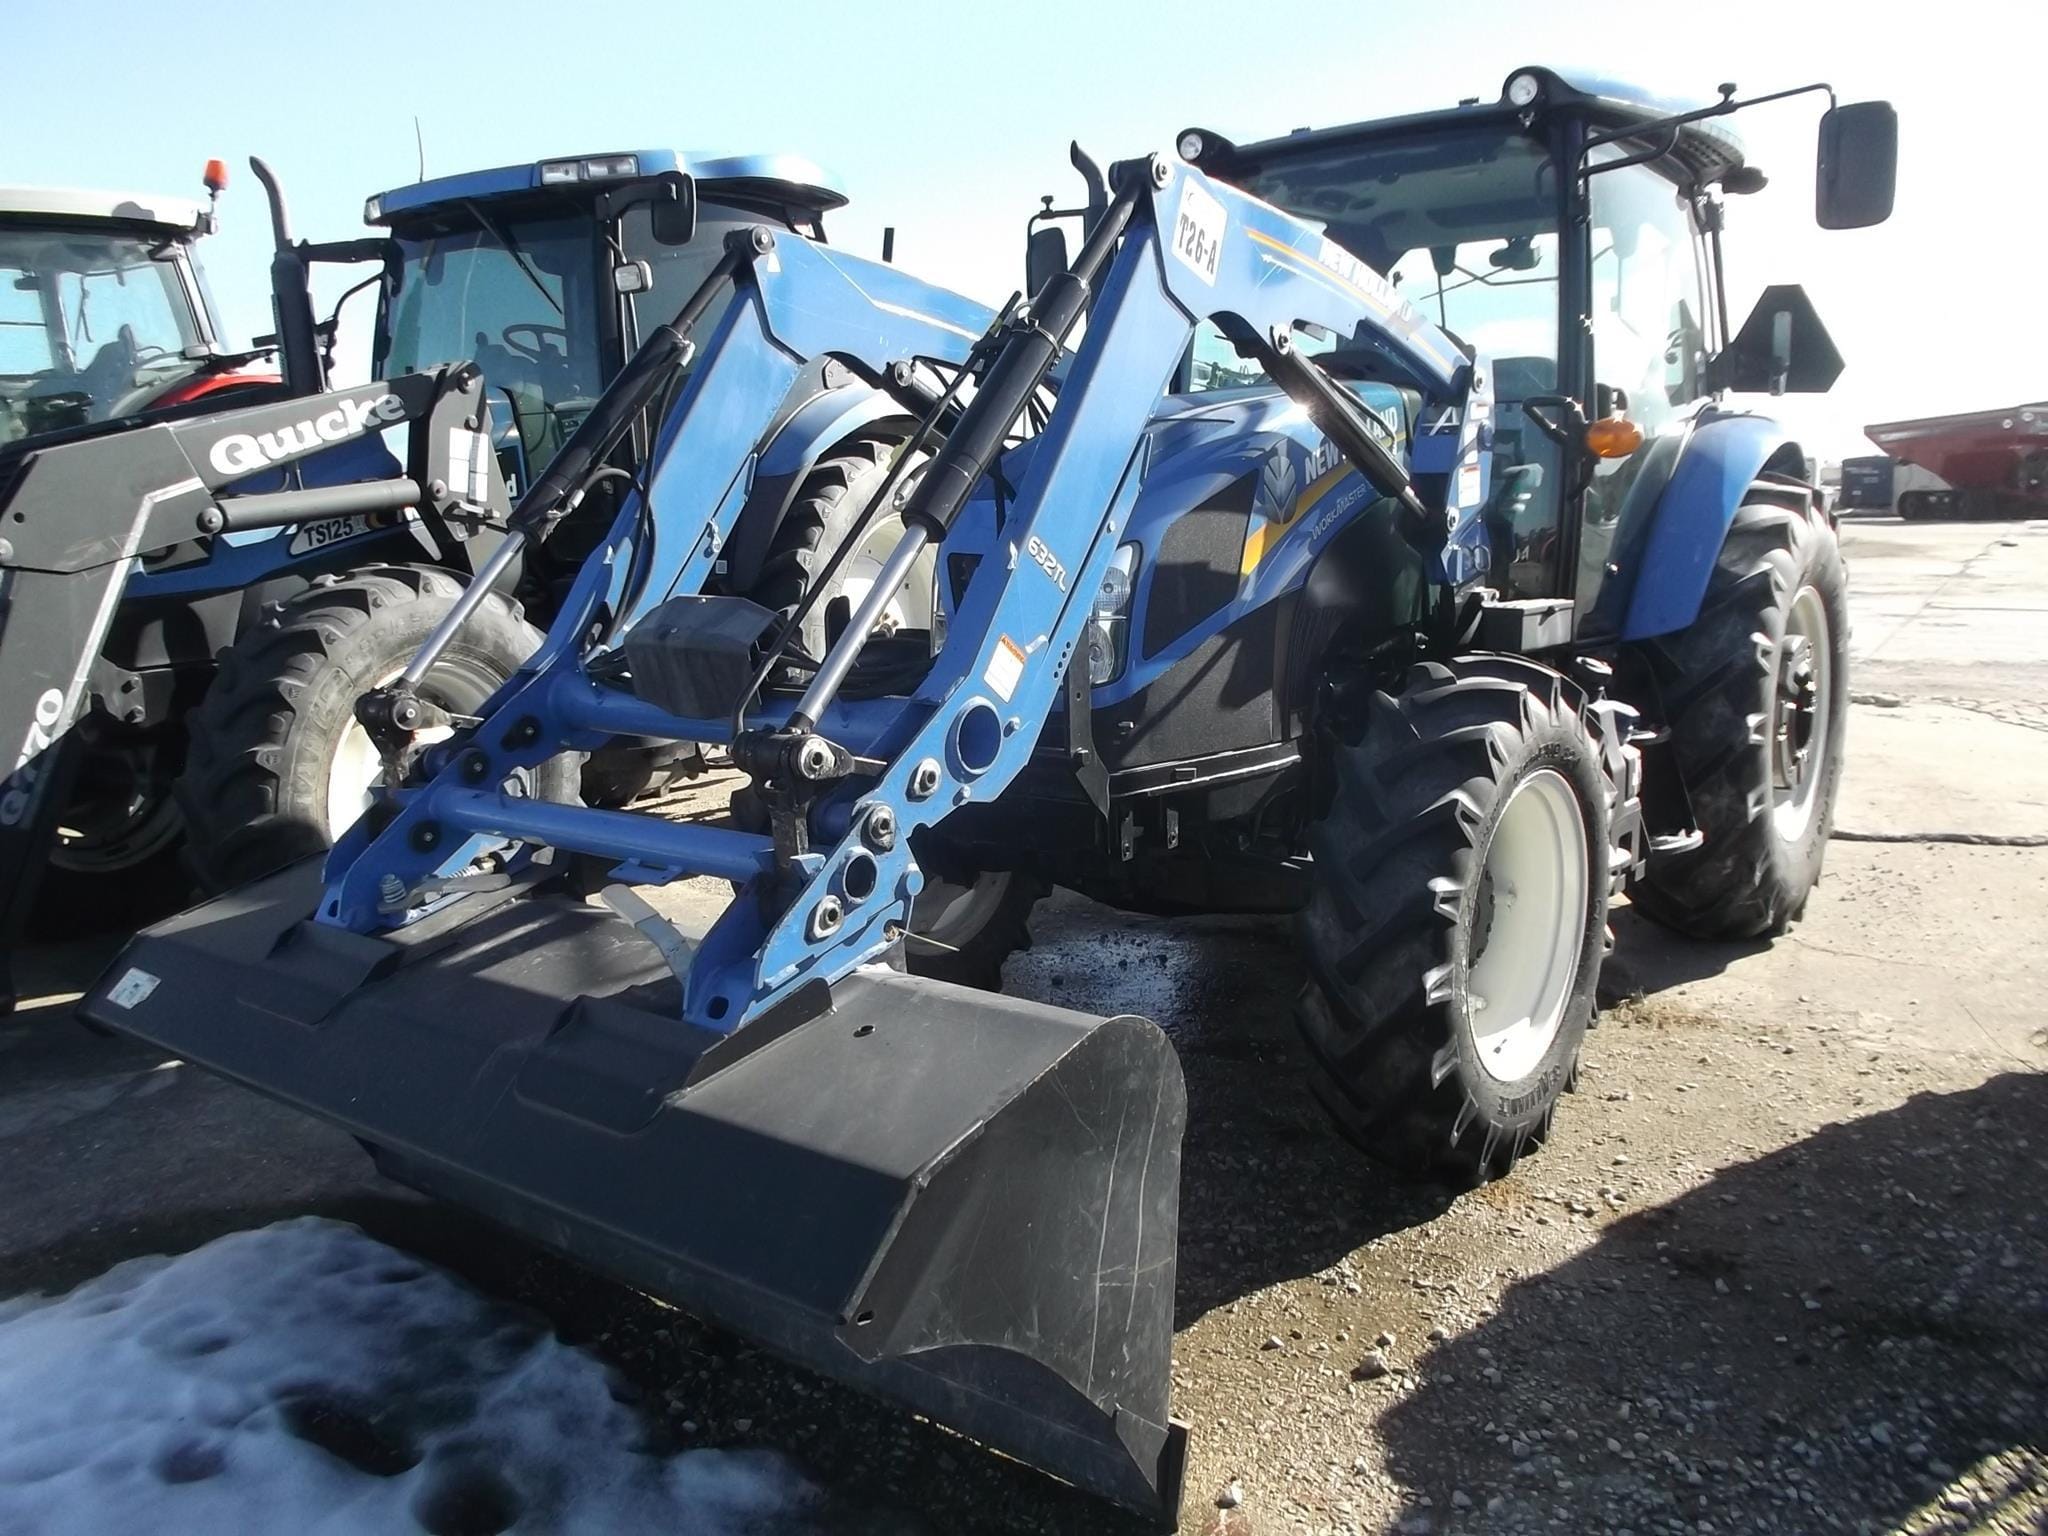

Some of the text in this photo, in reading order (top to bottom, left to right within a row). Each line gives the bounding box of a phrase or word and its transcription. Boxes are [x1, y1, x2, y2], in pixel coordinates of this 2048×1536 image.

[1178, 212, 1217, 275] T26-A
[209, 393, 406, 475] Quicke
[1305, 440, 1340, 485] NEW
[1310, 483, 1368, 540] WORKMASTER
[1027, 535, 1067, 593] 632TL
